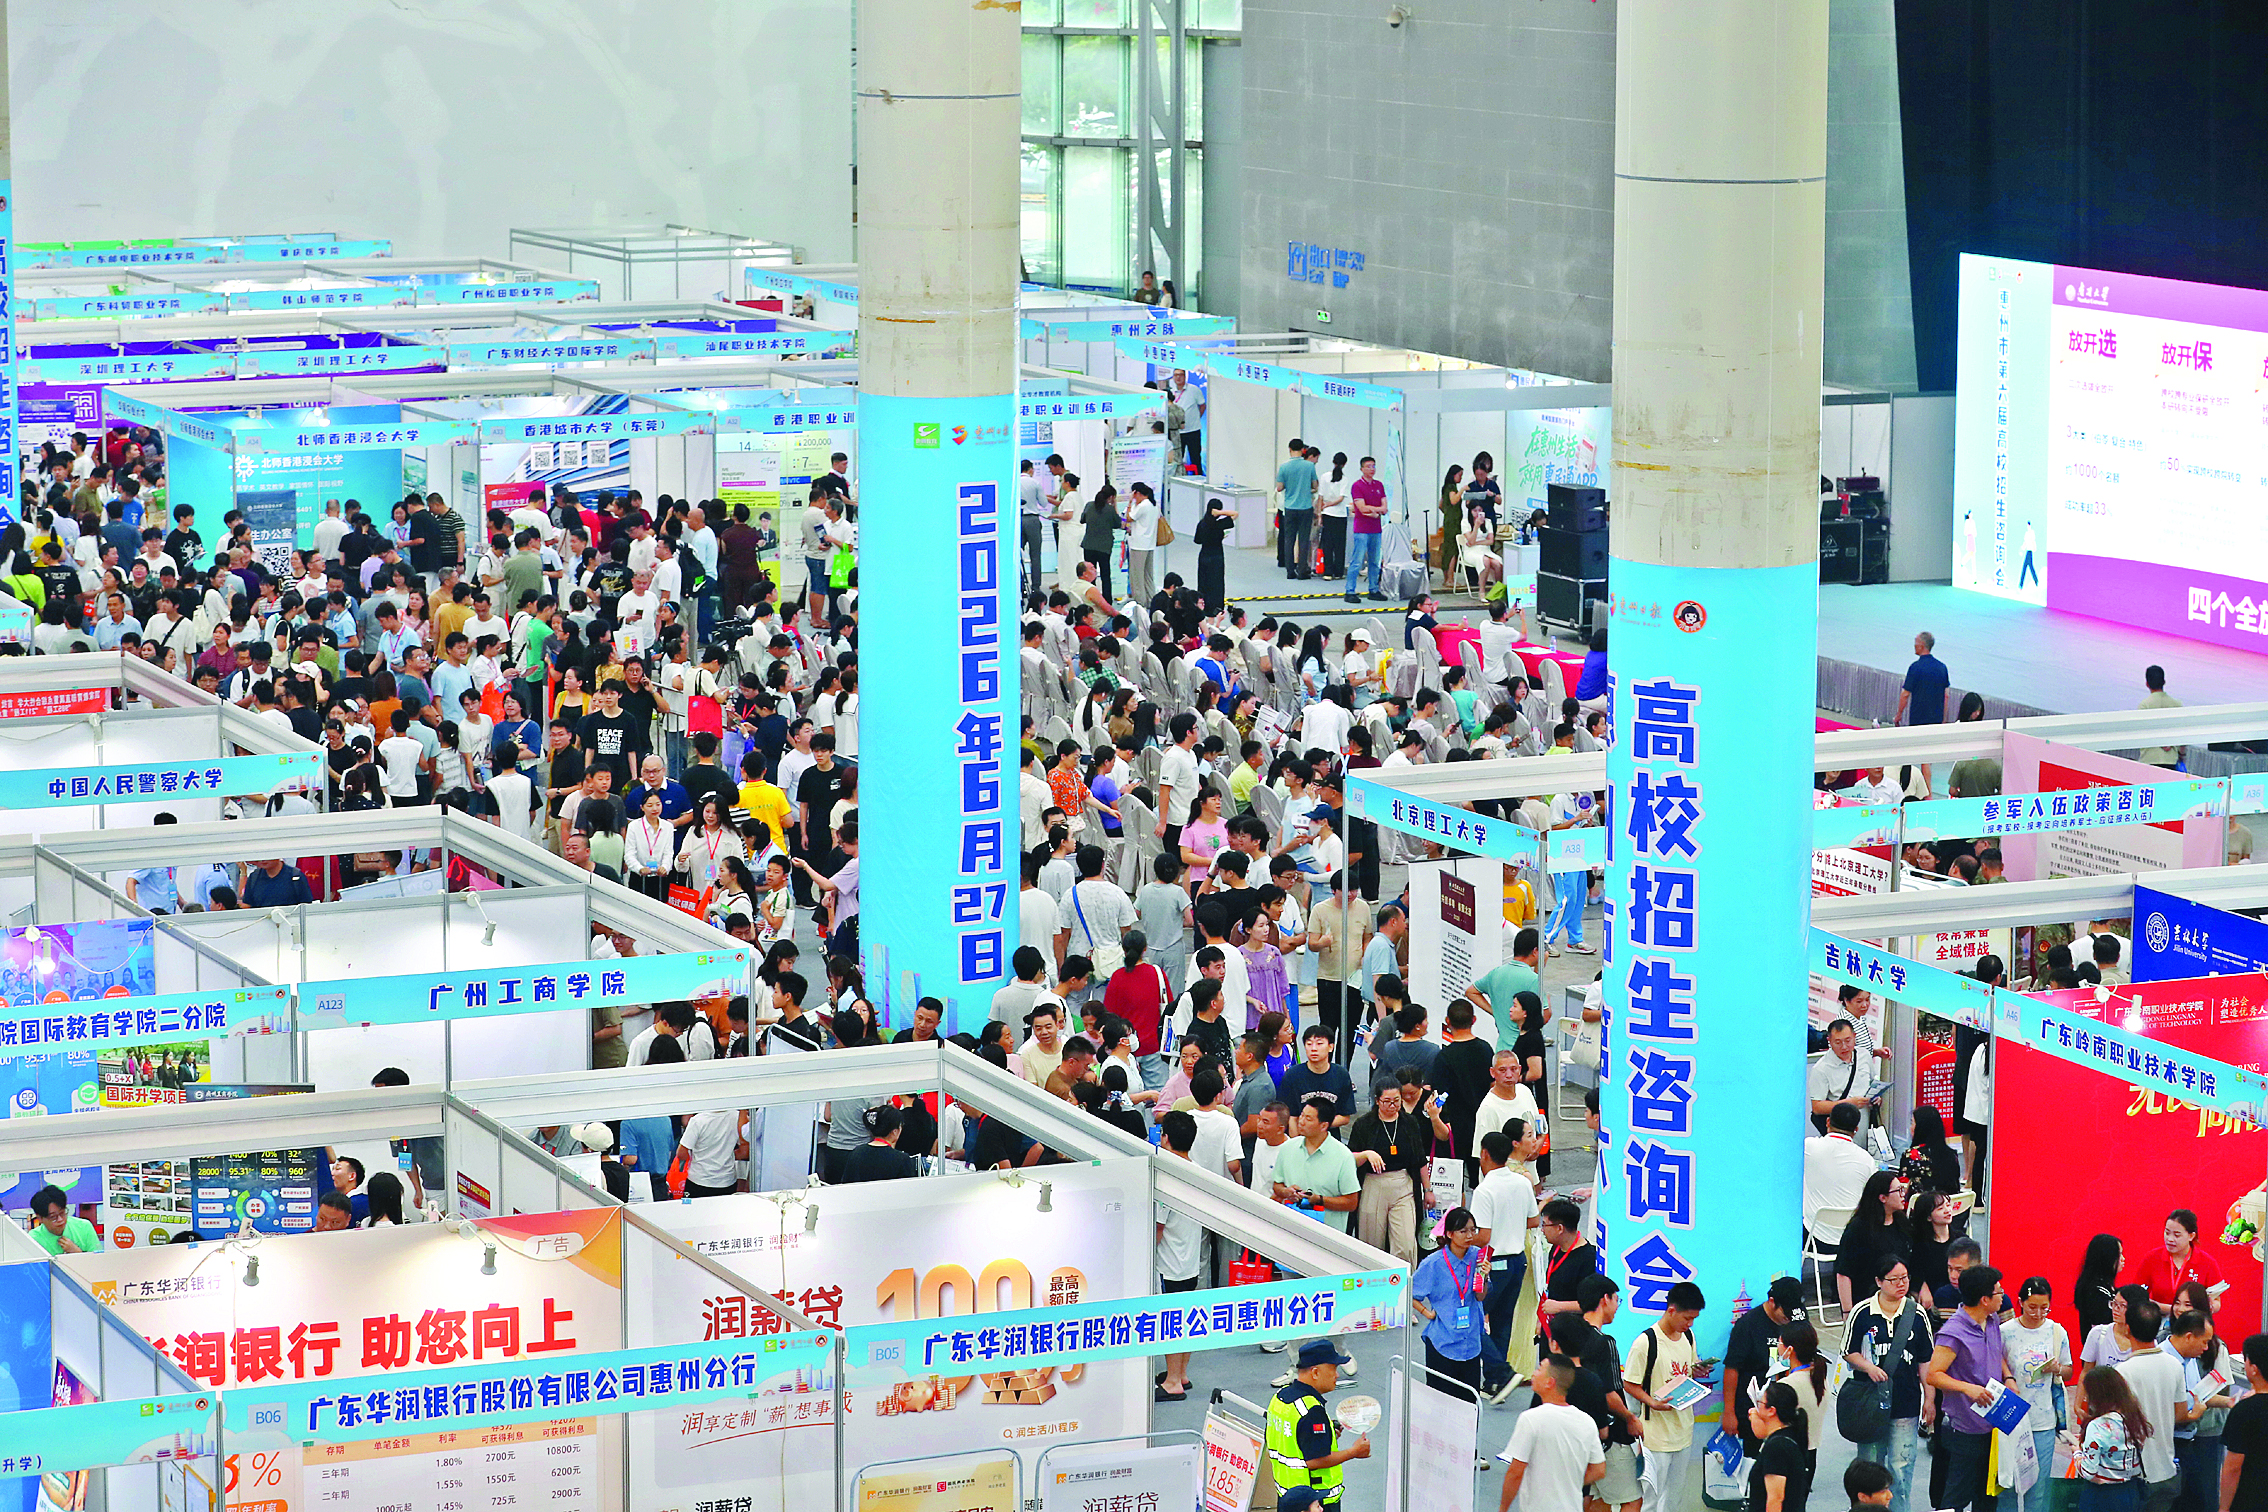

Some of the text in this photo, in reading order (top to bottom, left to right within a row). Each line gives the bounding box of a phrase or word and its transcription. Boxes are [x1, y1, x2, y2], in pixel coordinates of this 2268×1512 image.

[86, 252, 195, 264] 广东邮电职业技术学院
[282, 293, 363, 305] 韩山师范学院
[1111, 324, 1175, 337] 惠州文脉
[487, 344, 618, 360] 广东财经大学国际学院
[705, 337, 806, 351] 汕尾职业技术学院
[2069, 329, 2117, 358] 放开选
[297, 353, 389, 368] 深圳理工大学
[1143, 345, 1176, 363] 小惠研学
[2161, 340, 2213, 371] 放开保
[80, 361, 175, 376] 深圳理工大学
[1237, 364, 1270, 382] 小惠研学
[297, 429, 421, 446] 北师香港浸会大学
[1525, 426, 1579, 458] 在惠州生活
[261, 454, 344, 468] 北师香港浸会大学
[597, 729, 623, 737] PEACE
[955, 485, 1006, 981] 2026年6月27日
[49, 768, 222, 799] 中国人民警察大学
[1984, 787, 2155, 821] 参军入伍政策咨询
[1392, 799, 1487, 846] 北京理工大学
[1565, 843, 1581, 854] A38
[2173, 923, 2209, 950] 吉林大学
[1936, 941, 1990, 960] 全域慑战
[1825, 942, 1907, 993] 吉林大学
[429, 972, 627, 1011] 广州工商学院
[1625, 681, 1702, 1311] 高校招生咨询会
[318, 999, 343, 1011] A123
[2220, 996, 2249, 1009] 为社会
[2041, 1016, 2217, 1098] 广东岭南职业技术学院
[1105, 1202, 1122, 1213] 广告
[536, 1236, 569, 1256] 广告
[697, 1236, 764, 1251] 广东华润银行
[123, 1274, 221, 1297] 广东华润银行
[1050, 1274, 1079, 1292] 最高
[1050, 1291, 1079, 1305] 额度
[925, 1292, 1335, 1366] 广东华润银行股份有限公司惠州分行
[145, 1298, 576, 1387] 润银行 助您向上
[875, 1347, 899, 1361] B05
[309, 1354, 756, 1431] 广东华润银行股份有限公司惠州分行
[256, 1410, 281, 1424] B06
[1016, 1419, 1079, 1438] 润生活小程序
[326, 1424, 585, 1456] 存期 单笔金额 利率 可获得利息 可获得利息
[321, 1443, 581, 1479] 三年期 1.80% 2700元 10800元
[436, 1465, 581, 1490] 1.55% 1550元 6200元
[1069, 1471, 1107, 1480] 广东华润银行
[321, 1487, 581, 1507] 二年期 725元 2900元
[878, 1488, 910, 1496] 广东华润银行
[436, 1501, 463, 1512] 1.45%
